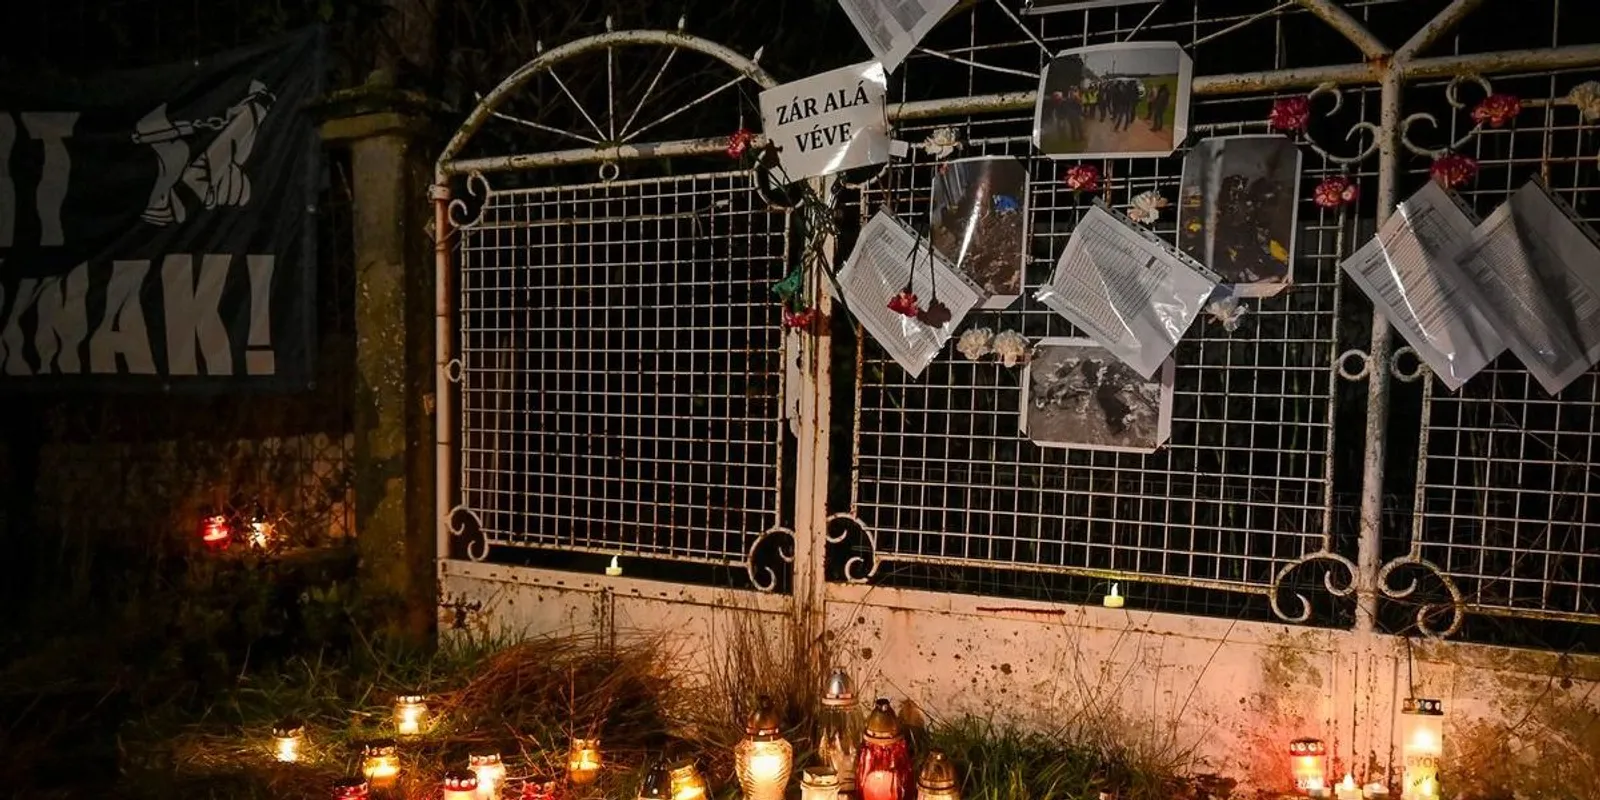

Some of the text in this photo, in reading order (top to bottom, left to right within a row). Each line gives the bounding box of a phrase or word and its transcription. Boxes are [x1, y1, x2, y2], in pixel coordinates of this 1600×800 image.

[776, 80, 869, 126] ZÁR ALÁ
[795, 122, 852, 153] VÉVE
[0, 111, 81, 246] T
